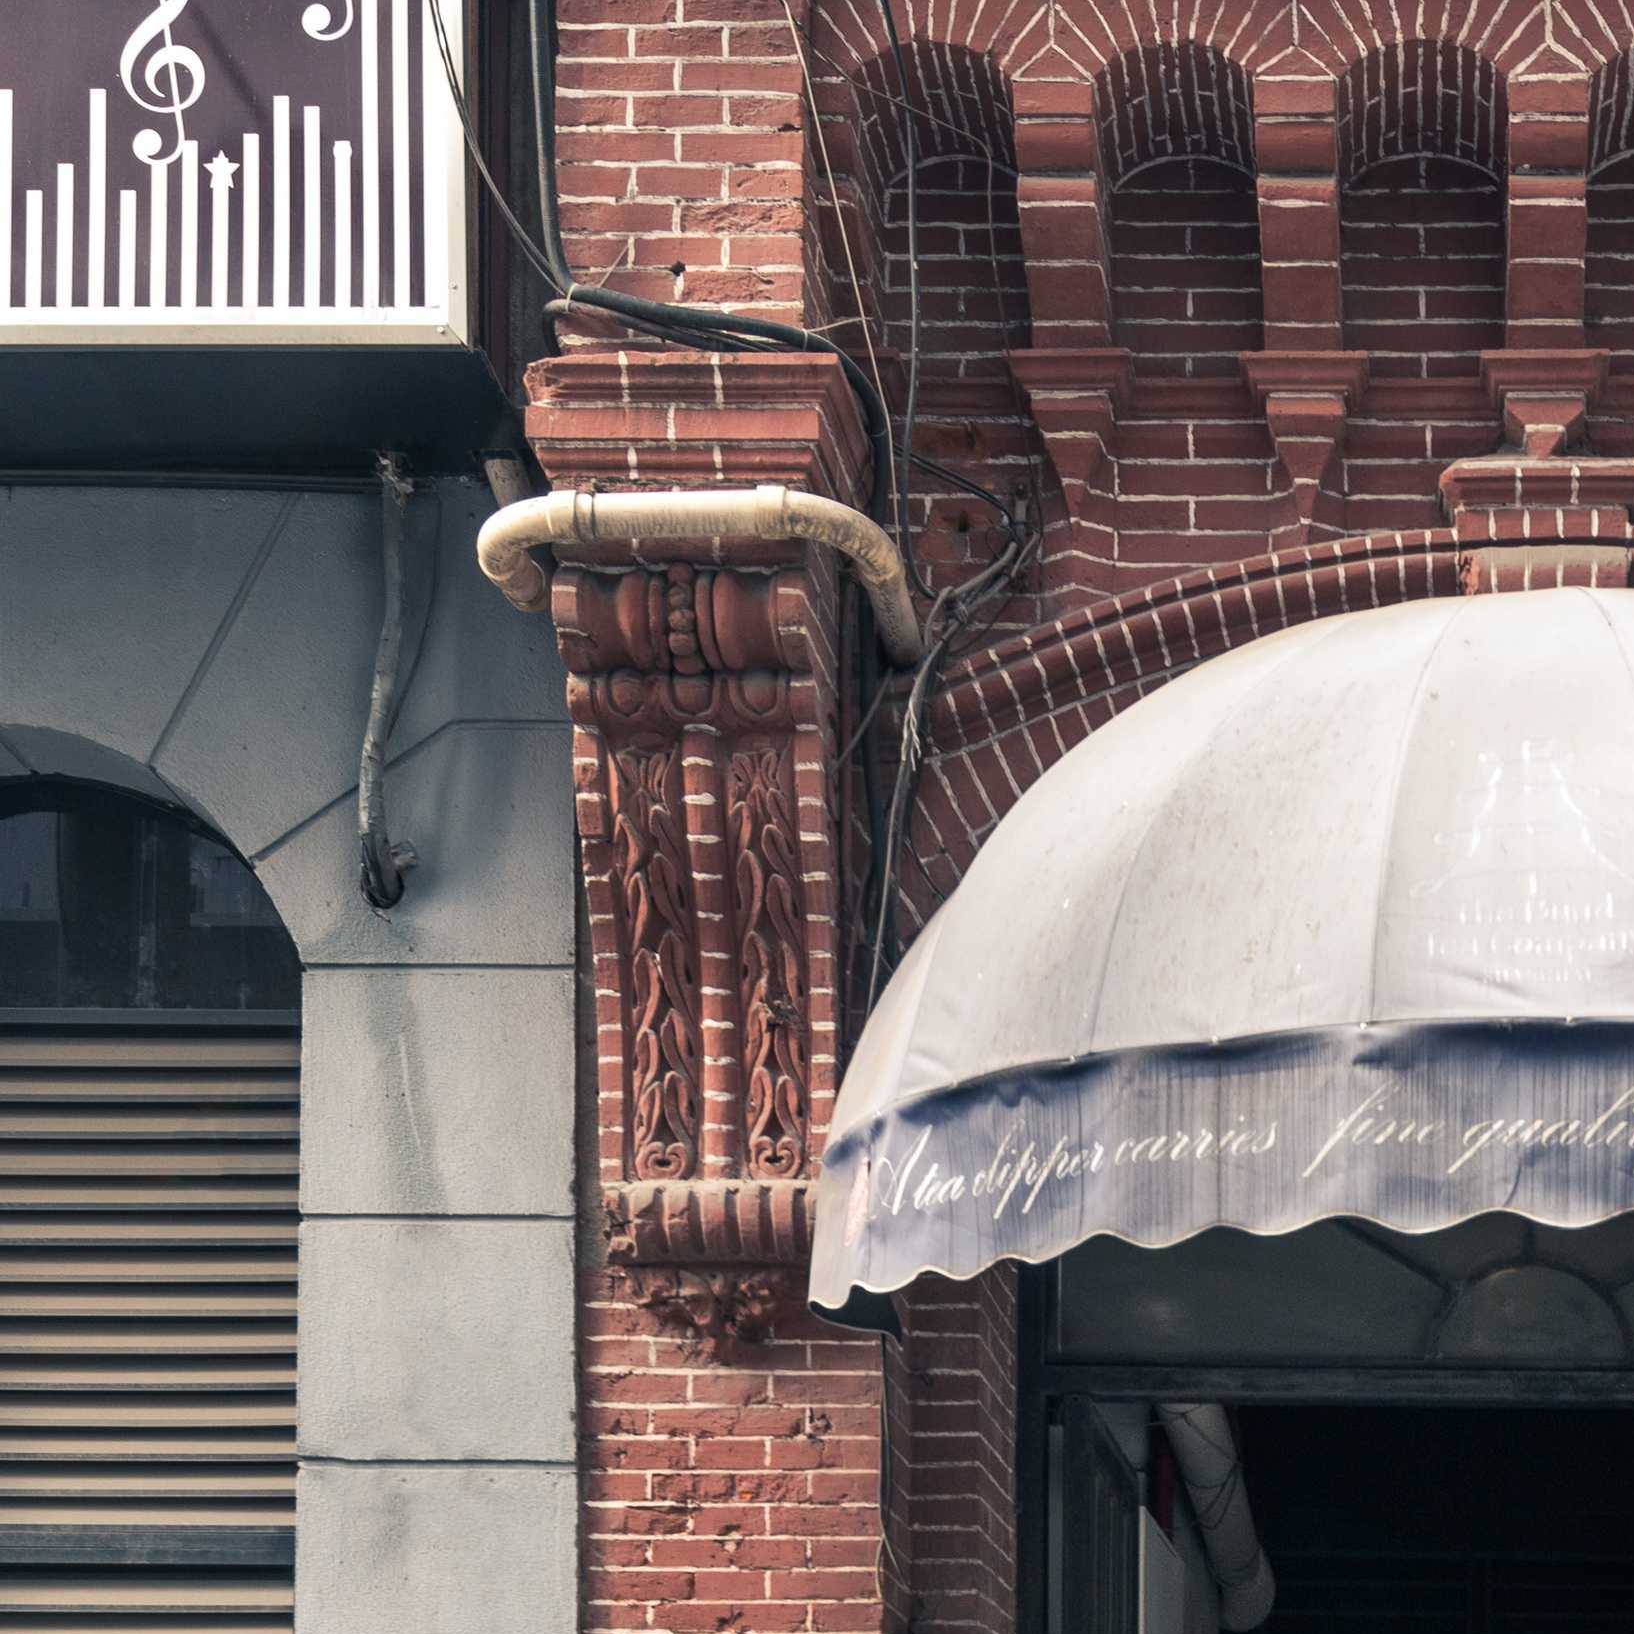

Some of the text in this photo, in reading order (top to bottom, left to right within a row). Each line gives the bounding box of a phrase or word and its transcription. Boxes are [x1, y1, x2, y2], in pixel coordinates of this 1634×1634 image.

[872, 1124, 933, 1218] A
[913, 1160, 966, 1210] tea
[972, 1117, 1106, 1220] clipper
[1113, 1114, 1280, 1165] carries
[1302, 1076, 1447, 1179] fine
